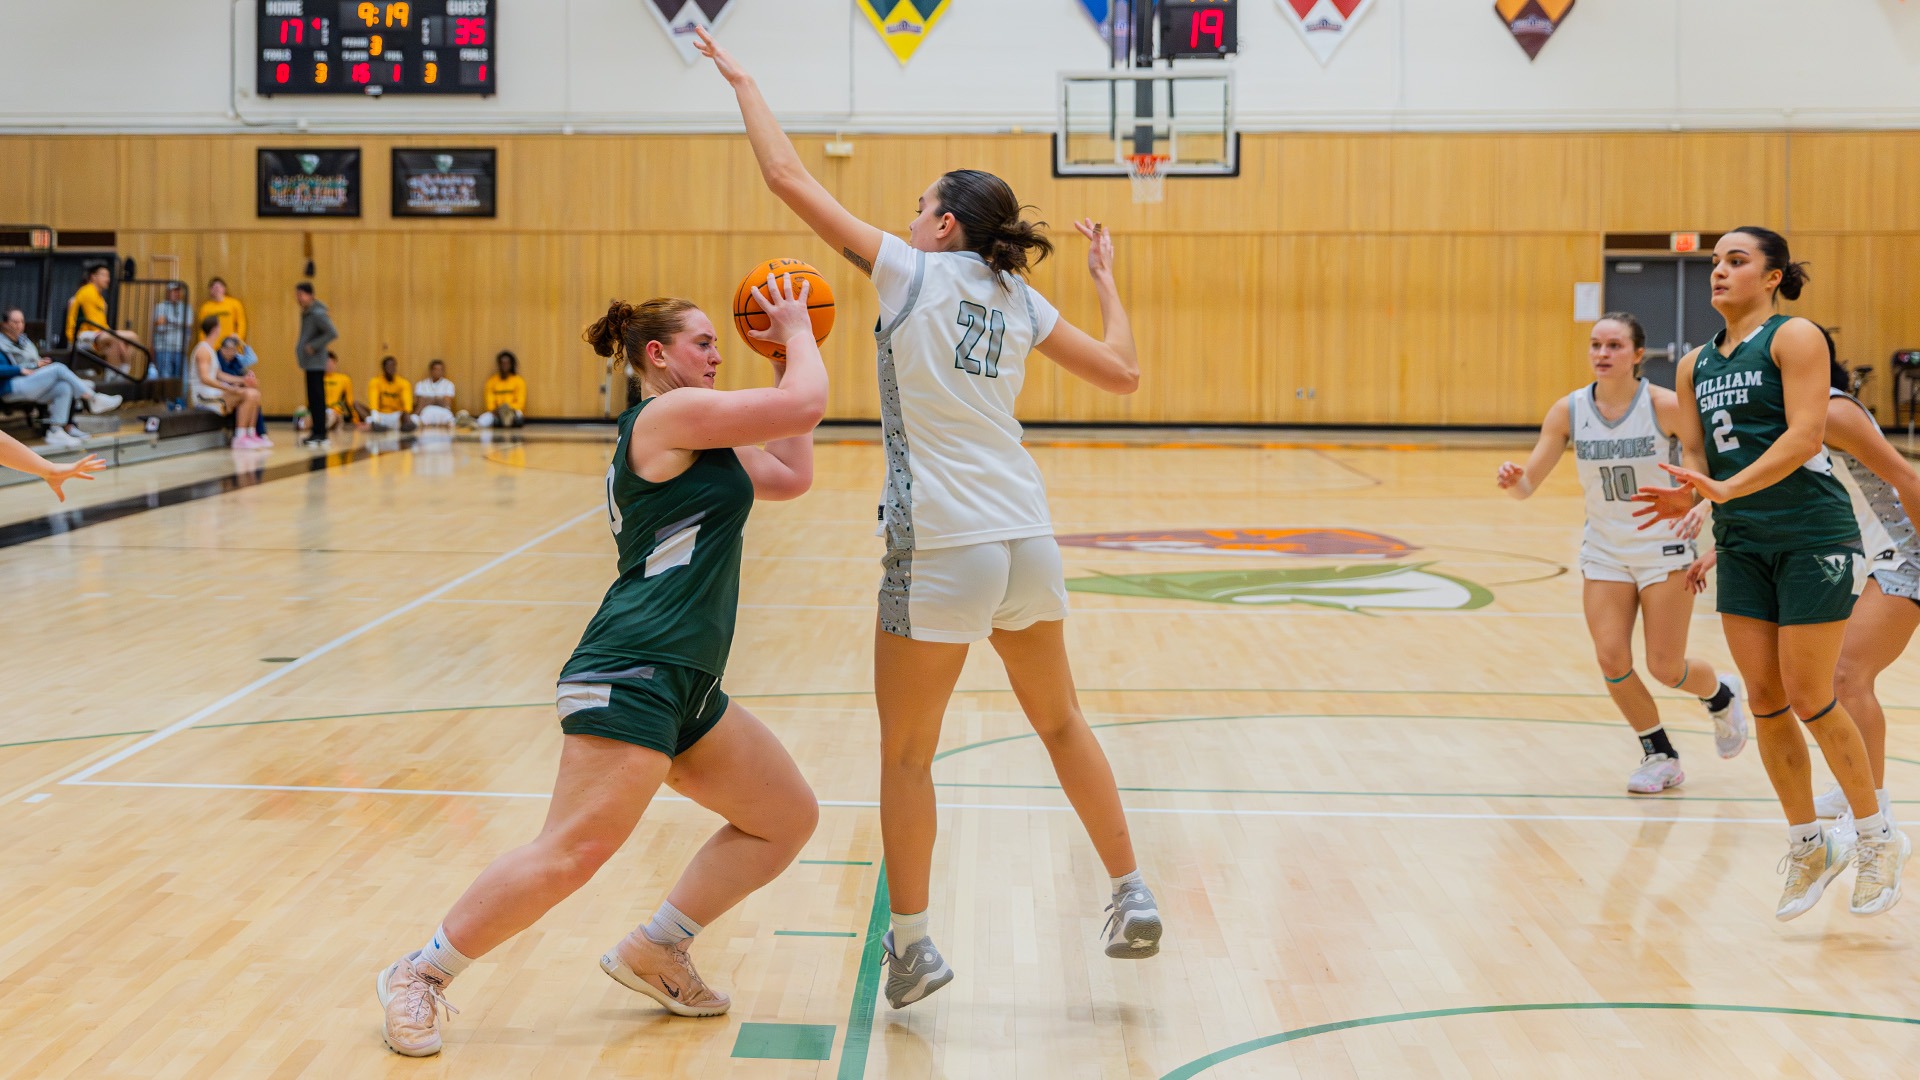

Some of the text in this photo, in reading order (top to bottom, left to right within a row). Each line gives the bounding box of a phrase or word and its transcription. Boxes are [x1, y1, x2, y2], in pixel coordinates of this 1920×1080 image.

[357, 1, 410, 28] 9:19
[280, 18, 304, 44] 17
[454, 17, 486, 45] 35
[1190, 9, 1224, 49] 19
[369, 35, 383, 56] 3
[314, 62, 328, 84] 3
[393, 64, 401, 82] 1
[424, 62, 438, 84] 3
[478, 64, 487, 82] 1
[954, 300, 1006, 378] 21
[1700, 388, 1749, 414] SMITH
[1711, 409, 1740, 454] 2
[1599, 465, 1639, 501] 10
